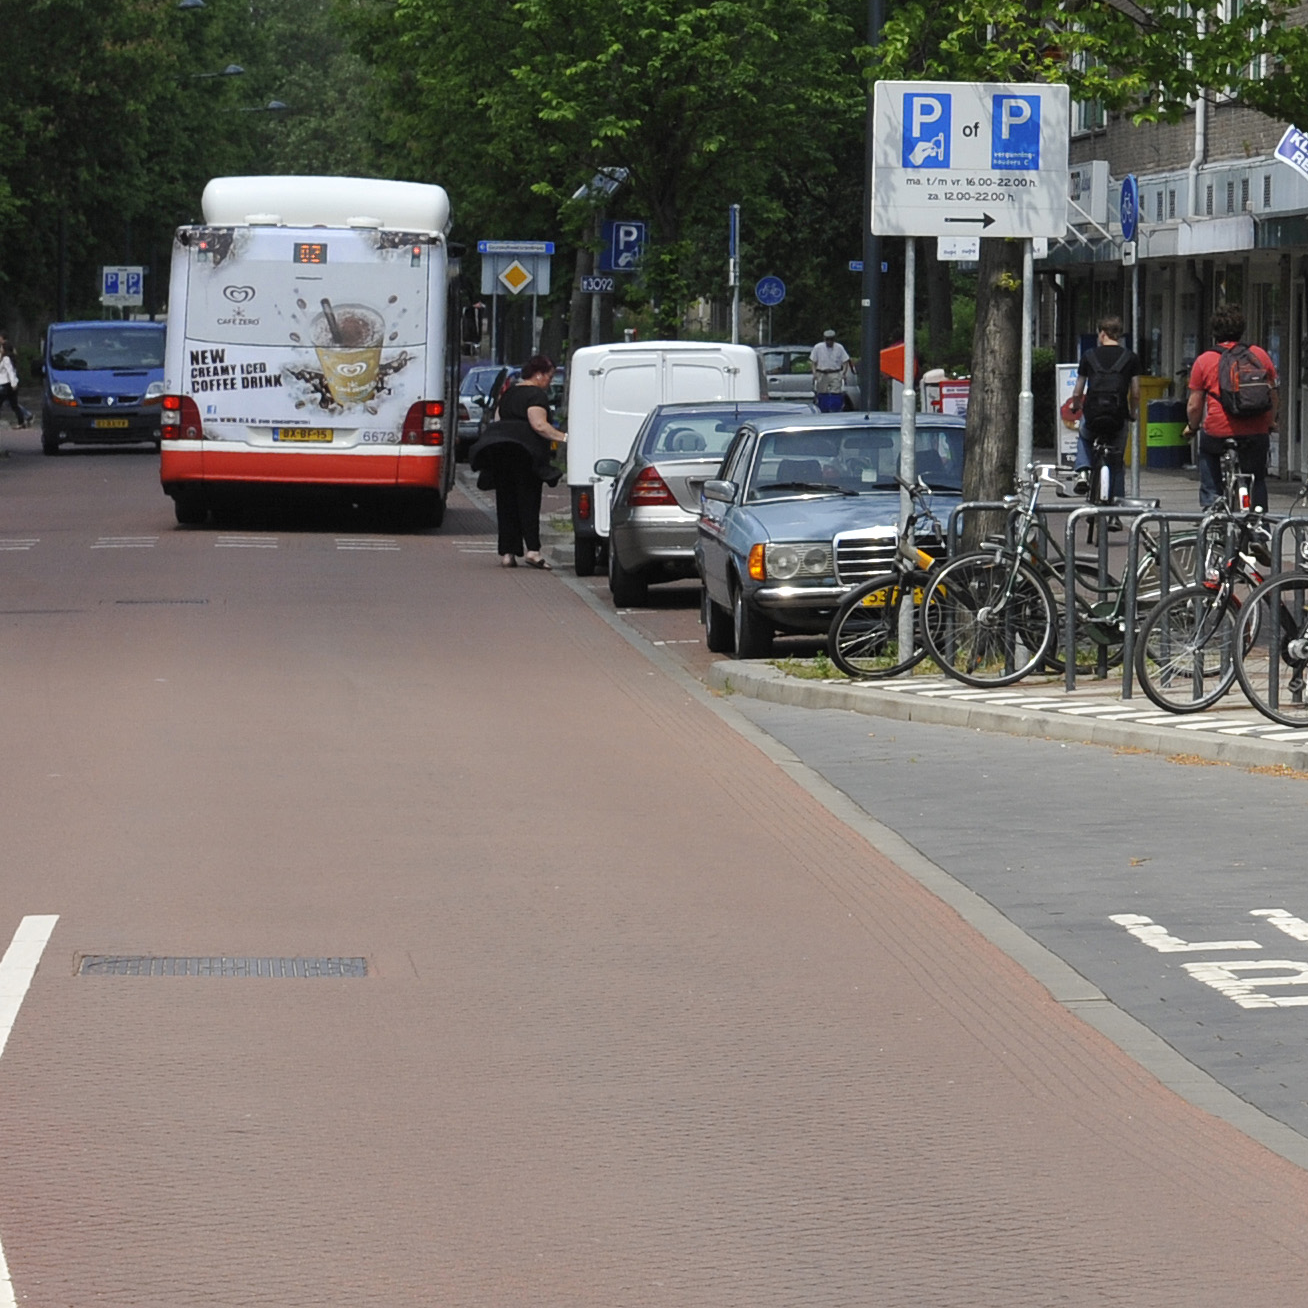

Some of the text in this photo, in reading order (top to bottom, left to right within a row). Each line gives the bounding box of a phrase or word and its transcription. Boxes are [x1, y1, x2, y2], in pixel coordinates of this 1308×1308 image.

[962, 122, 980, 137] of
[994, 151, 1035, 160] vergunning-
[906, 178, 923, 186] ma.
[926, 177, 948, 186] t/m
[965, 178, 1027, 187] 16.00-22.00
[944, 192, 1005, 202] 12.00-22.00
[587, 278, 613, 291] 3092
[190, 349, 226, 366] NEW
[191, 362, 267, 379] CREAMY ICED
[192, 374, 283, 393] COFFEE DRINK
[363, 431, 394, 442] 6672
